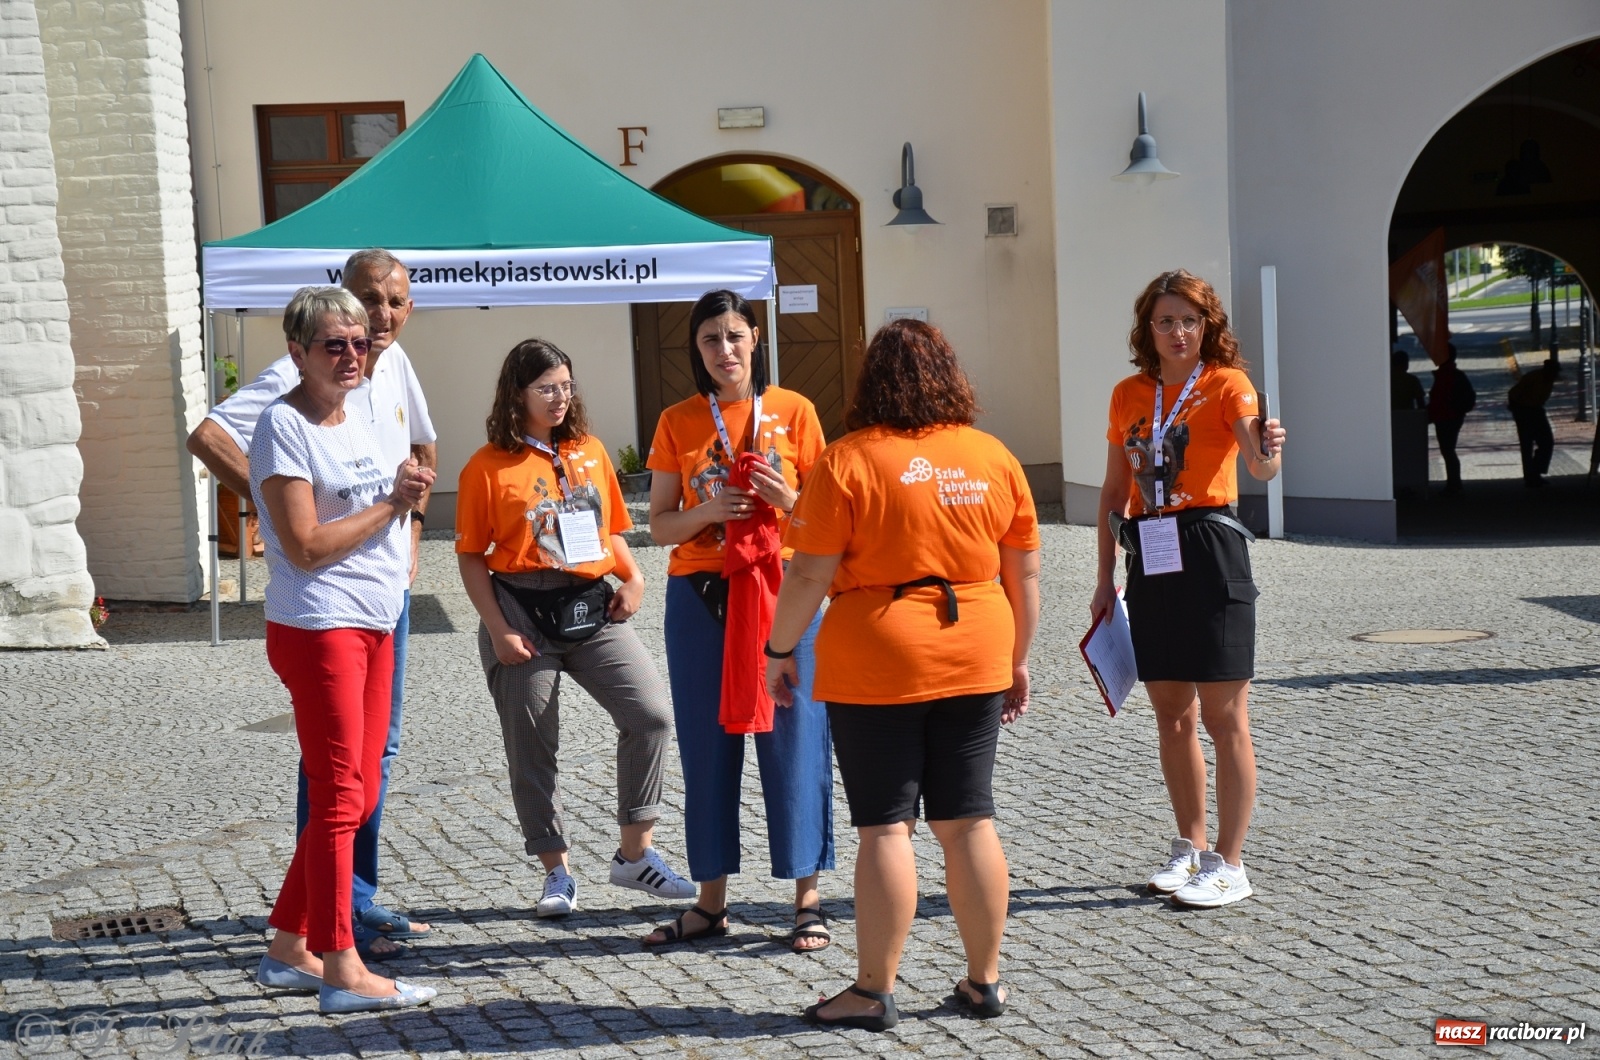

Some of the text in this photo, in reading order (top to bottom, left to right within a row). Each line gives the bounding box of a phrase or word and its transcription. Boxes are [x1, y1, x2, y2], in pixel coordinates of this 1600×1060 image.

[617, 126, 648, 166] F
[326, 257, 658, 287] wzamekpiastowski.pl
[934, 467, 966, 480] Szlak
[937, 480, 990, 495] Zabytków
[939, 493, 984, 506] Techniki
